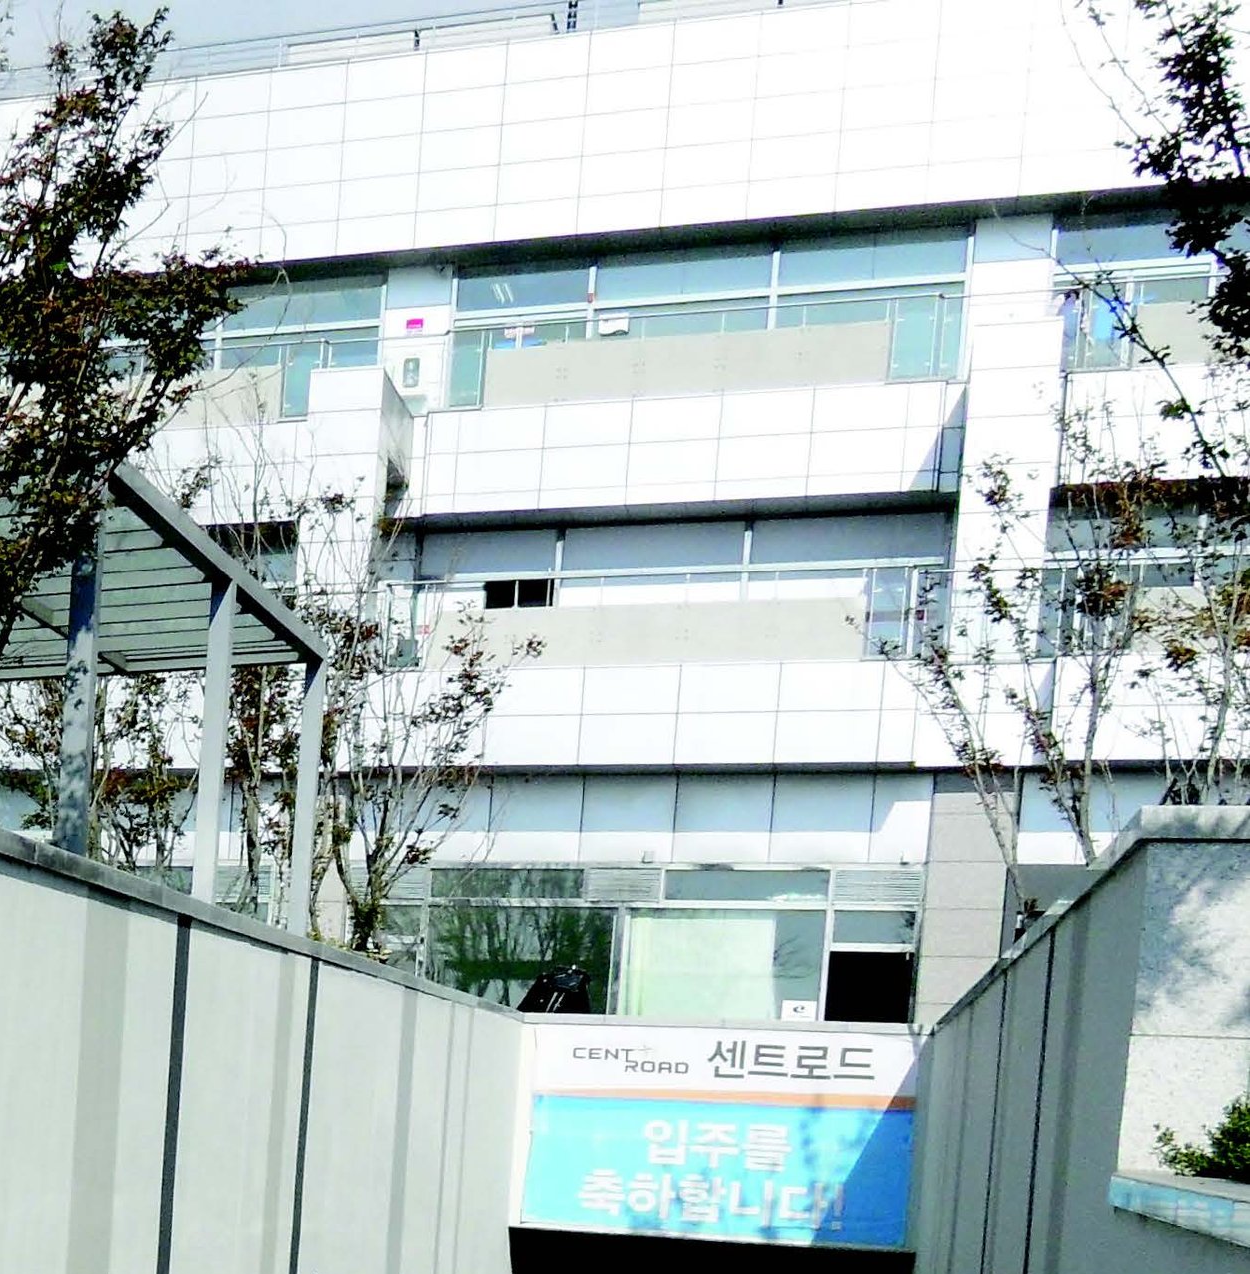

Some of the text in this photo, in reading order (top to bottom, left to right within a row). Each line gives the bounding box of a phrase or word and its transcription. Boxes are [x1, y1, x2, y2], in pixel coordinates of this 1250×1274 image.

[572, 1046, 633, 1064] CENT
[624, 1059, 690, 1076] ROAD
[707, 1040, 876, 1081] 센트로드
[643, 1118, 792, 1173] 입주를
[577, 1169, 845, 1231] 축하합니다!
